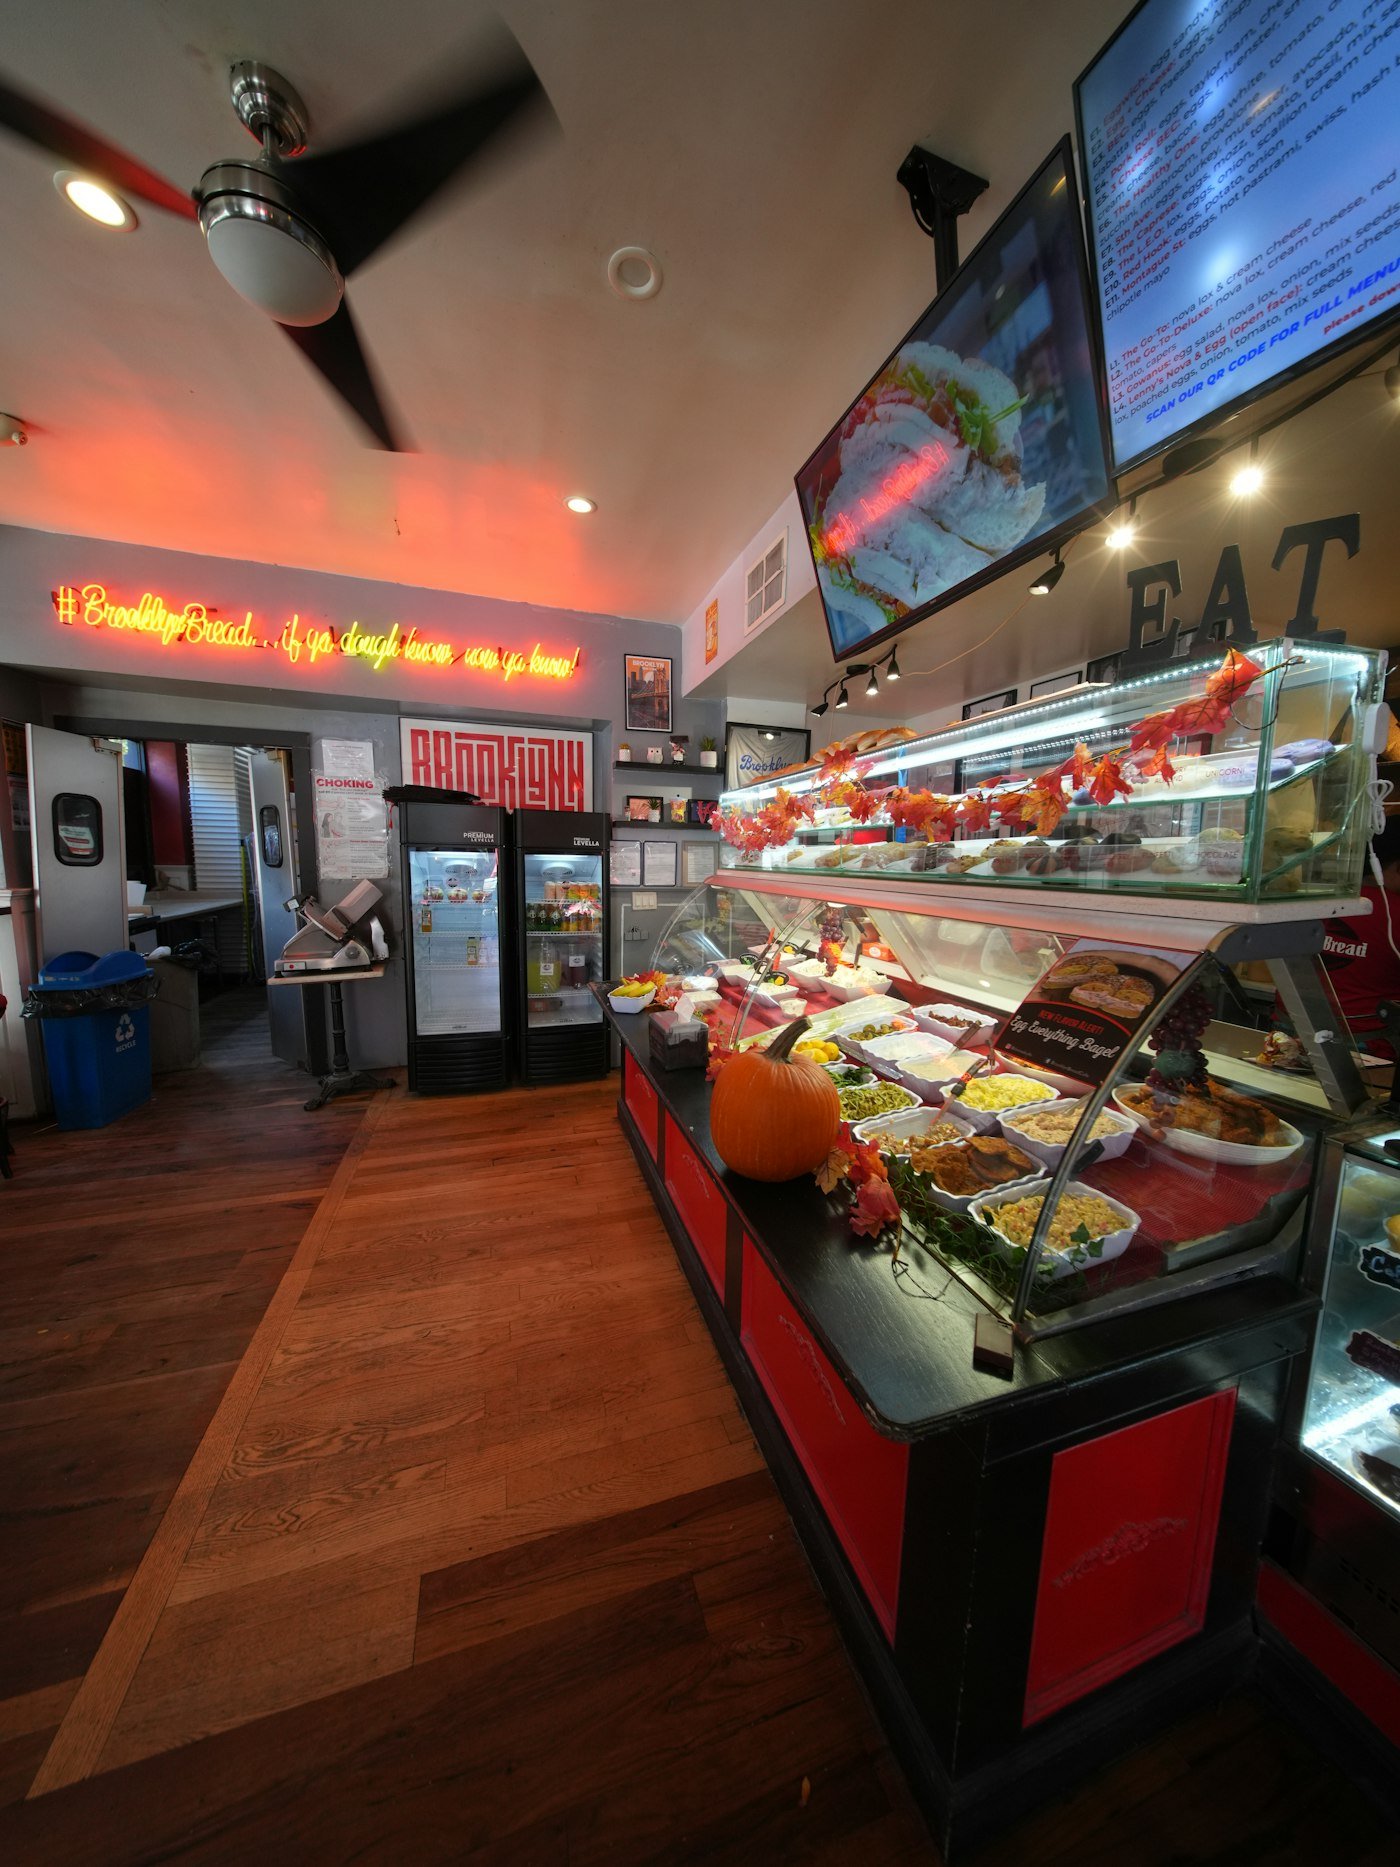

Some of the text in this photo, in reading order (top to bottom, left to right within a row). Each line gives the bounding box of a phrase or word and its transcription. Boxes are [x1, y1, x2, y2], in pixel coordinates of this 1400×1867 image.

[1094, 179, 1109, 195] E4.
[1110, 152, 1133, 179] Pork
[1189, 59, 1222, 98] taylor
[1224, 28, 1257, 62] ham,
[1096, 190, 1110, 208] E5.
[1118, 145, 1155, 185] Cheese
[1215, 20, 1281, 88] muenster,
[1098, 217, 1113, 234] E6.
[1113, 198, 1132, 219] The
[1133, 159, 1171, 201] Healthy
[1203, 107, 1226, 134] egg
[1227, 70, 1267, 109] white,
[1269, 15, 1325, 69] tomato,
[1150, 48, 1171, 74] egg
[1093, 120, 1147, 183] ciabatta roll
[1096, 190, 1126, 221] cream
[1164, 119, 1198, 155] bacon
[1099, 91, 1261, 248] zucchini, mushroom, provolone
[1101, 243, 1115, 260] E7.
[1115, 227, 1132, 247] 5th
[1184, 145, 1222, 183] turkey,
[1292, 20, 1358, 84] avocado,
[1102, 256, 1117, 273] E8.
[1117, 239, 1135, 257] The
[1136, 199, 1181, 242] Caprese:
[1213, 137, 1248, 172] mozz,
[1250, 91, 1302, 139] tomato,
[1346, 19, 1378, 53] mix
[1103, 268, 1118, 285] E9.
[1118, 252, 1136, 271] The
[1217, 149, 1256, 184] onion,
[1256, 100, 1308, 151] scallion
[1310, 54, 1359, 102] cream
[1105, 293, 1121, 310] E11.
[1121, 250, 1170, 296] Montague
[1220, 191, 1241, 214] hot
[1242, 138, 1303, 198] pastrami,
[1304, 103, 1349, 144] swiss,
[1350, 65, 1391, 104] hash
[1104, 278, 1122, 298] E10.
[1122, 259, 1142, 281] Red
[1143, 234, 1174, 264] Hook:
[1205, 173, 1246, 214] potato,
[1247, 138, 1285, 175] onion
[1110, 168, 1397, 383] L2. The Go-To-Deluxe: nova lox, cream cheese, red
[1121, 344, 1139, 362] The
[1140, 320, 1171, 349] Go-To:
[1172, 302, 1196, 325] nova
[1198, 288, 1214, 307] lox
[1215, 281, 1225, 293] &
[1226, 252, 1264, 286] cream
[1265, 217, 1313, 257] cheese
[1105, 264, 1171, 321] chipotle mayo
[1112, 389, 1126, 405] L3.
[1126, 358, 1172, 395] Gowanus:
[1172, 344, 1194, 364] egg
[1194, 321, 1226, 349] salad,
[1226, 301, 1255, 326] nova
[1257, 287, 1279, 305] lox,
[1280, 257, 1323, 291] onion,
[1324, 235, 1353, 260] mix
[1113, 216, 1400, 416] L4. Lenny's Nova & Egg (open face): cream chees
[1130, 382, 1170, 418] poached
[1170, 366, 1199, 391] eggs,
[1199, 345, 1234, 373] onion,
[1234, 314, 1282, 348] tomato,
[1283, 293, 1310, 316] mix
[1310, 265, 1354, 300] seeds
[1145, 396, 1177, 425] SCAN
[1177, 379, 1205, 405] OUR
[1205, 366, 1227, 388] QR
[1227, 341, 1267, 374] CODE
[1269, 320, 1301, 349] FOR
[1303, 294, 1344, 327] FULL
[1347, 256, 1400, 300] MENU
[1322, 303, 1366, 337] please
[1111, 342, 1177, 393] tomato, capers
[281, 613, 303, 663] if
[306, 627, 335, 663] ya
[340, 620, 401, 669] dough
[463, 645, 500, 670] now
[500, 649, 526, 682] ya
[529, 642, 581, 678] know!
[1121, 511, 1361, 657] EAT
[632, 659, 665, 669] BROOKLYN
[316, 778, 374, 790] CHOKING
[463, 831, 494, 839] PREMIUM
[1323, 935, 1368, 958] Bread
[115, 1039, 137, 1053] RECYCLE
[1010, 1015, 1121, 1060] Egg Everything Bagel
